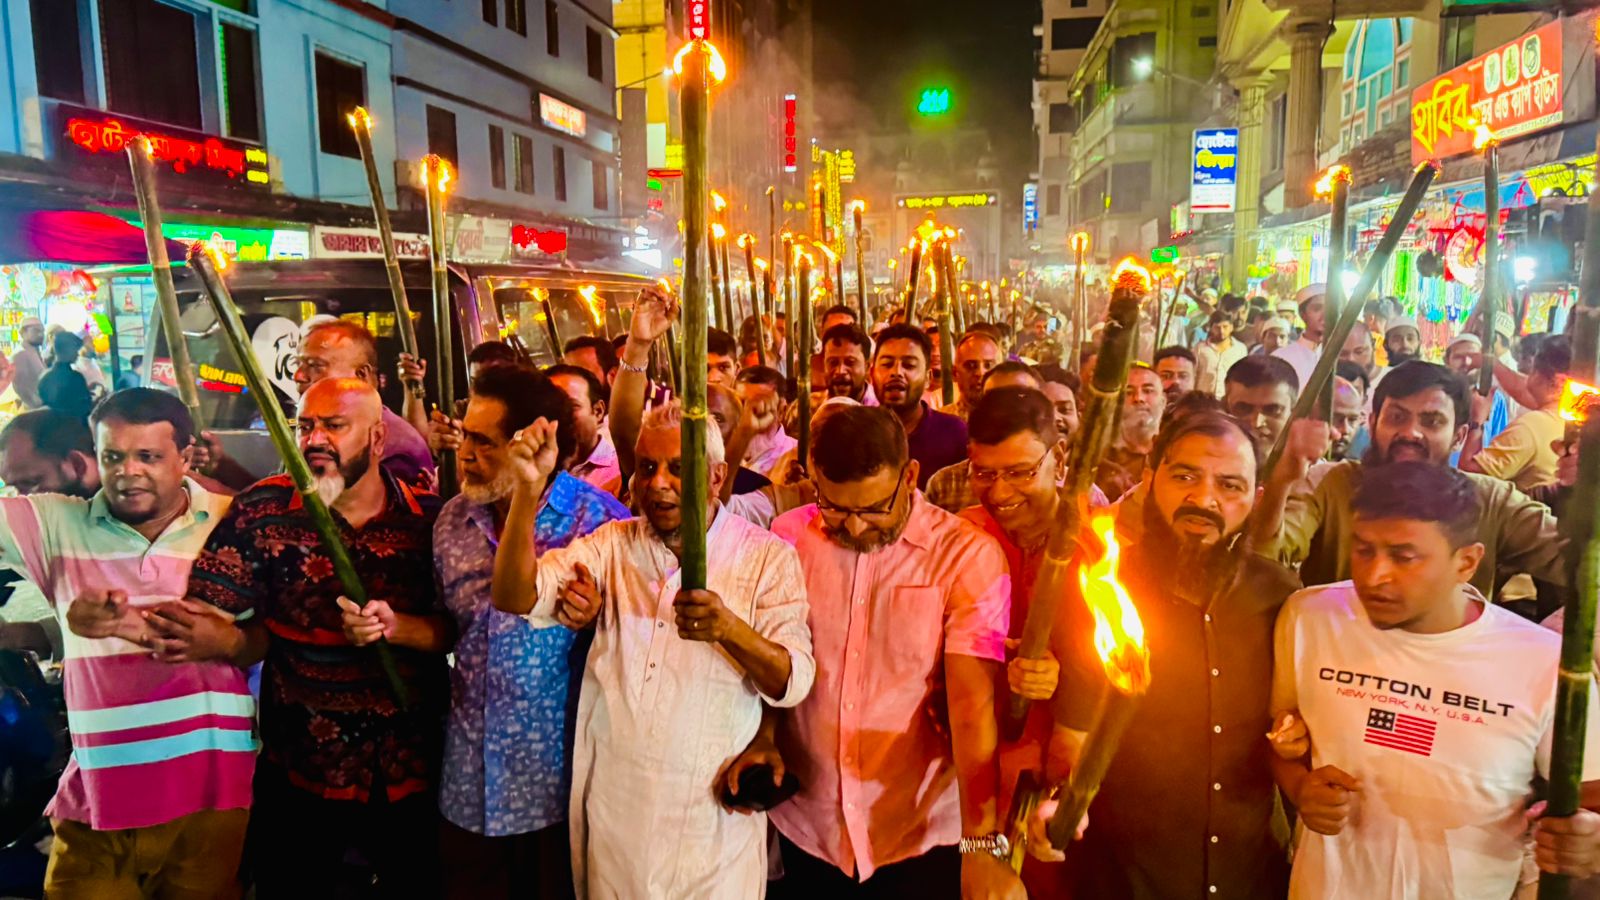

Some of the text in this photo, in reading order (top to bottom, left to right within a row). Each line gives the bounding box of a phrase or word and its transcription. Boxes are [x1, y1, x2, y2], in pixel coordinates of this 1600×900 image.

[1319, 667, 1515, 717] COTTON BELT
[1336, 687, 1367, 699] NEW
